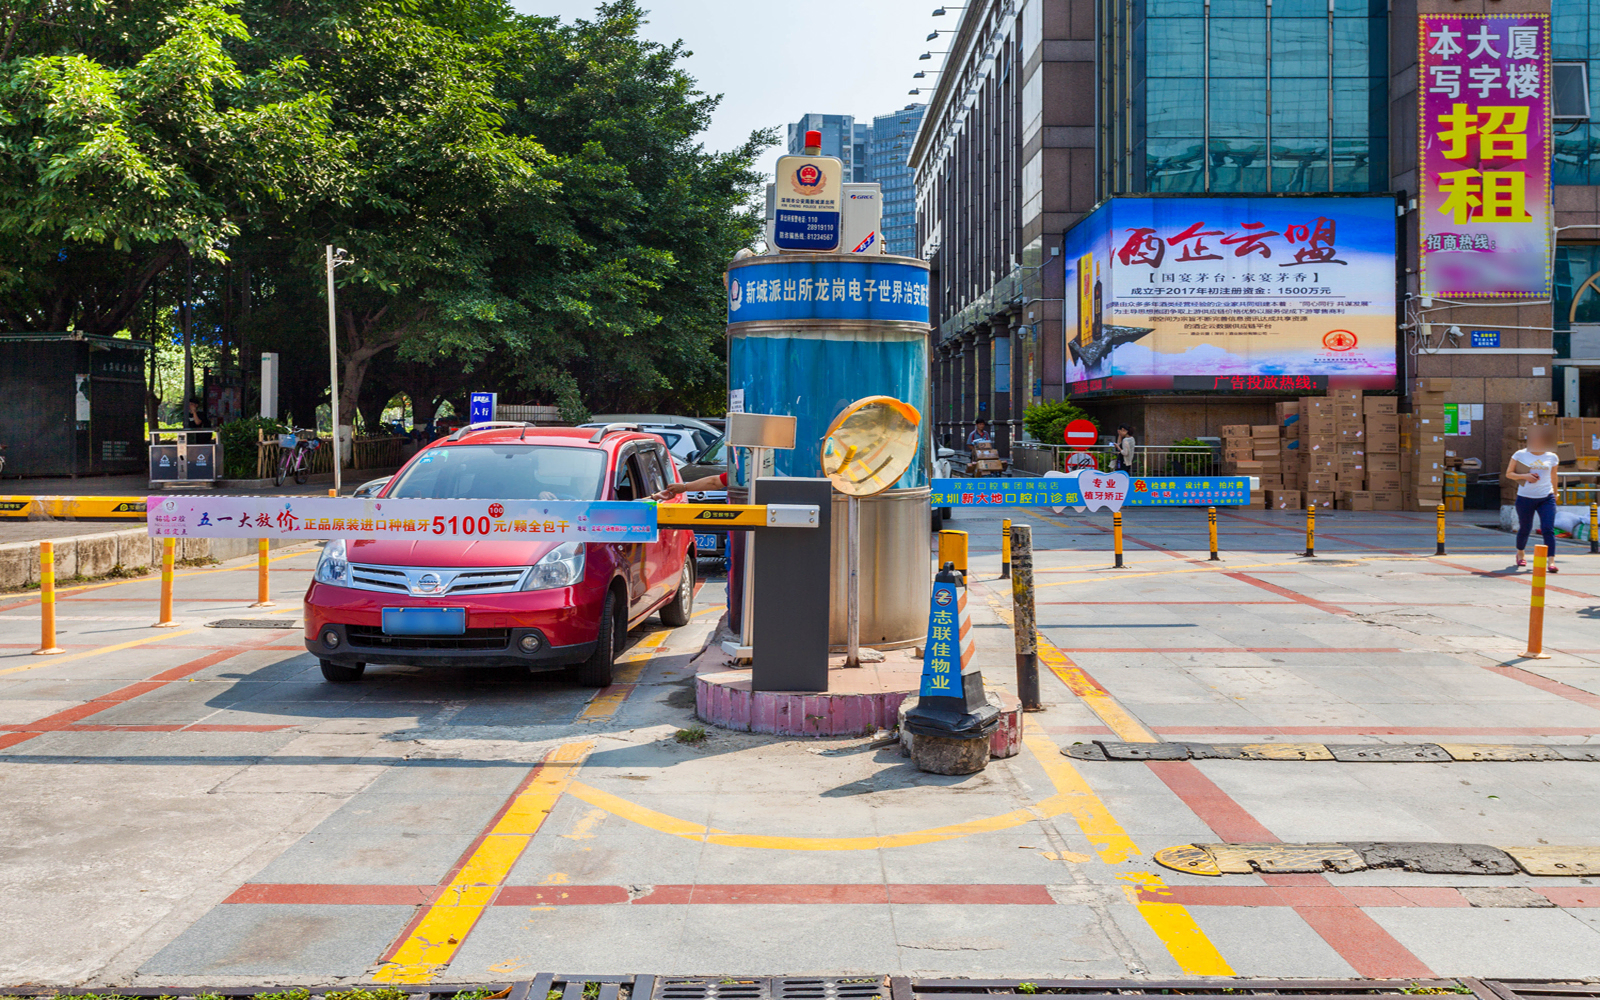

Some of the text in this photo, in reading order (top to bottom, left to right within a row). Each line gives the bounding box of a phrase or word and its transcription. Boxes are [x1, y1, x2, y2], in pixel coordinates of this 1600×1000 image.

[1429, 25, 1540, 60] 本大厦
[1429, 64, 1541, 99] 写字楼
[1437, 103, 1533, 226] 招租
[1109, 216, 1348, 270] 酒企云盟
[1427, 233, 1497, 251] 招商热线：
[1214, 375, 1318, 391] 广告投放热线：
[953, 482, 1059, 490] 双龙口腔集团旗舰店
[1092, 478, 1117, 489] 专业
[1134, 479, 1148, 493] 免
[931, 492, 1079, 504] 深圳新大地口腔门诊部
[1084, 491, 1124, 501] 植牙矫正
[197, 510, 299, 530] 五一大放价
[931, 610, 953, 690] 志联佳物业
